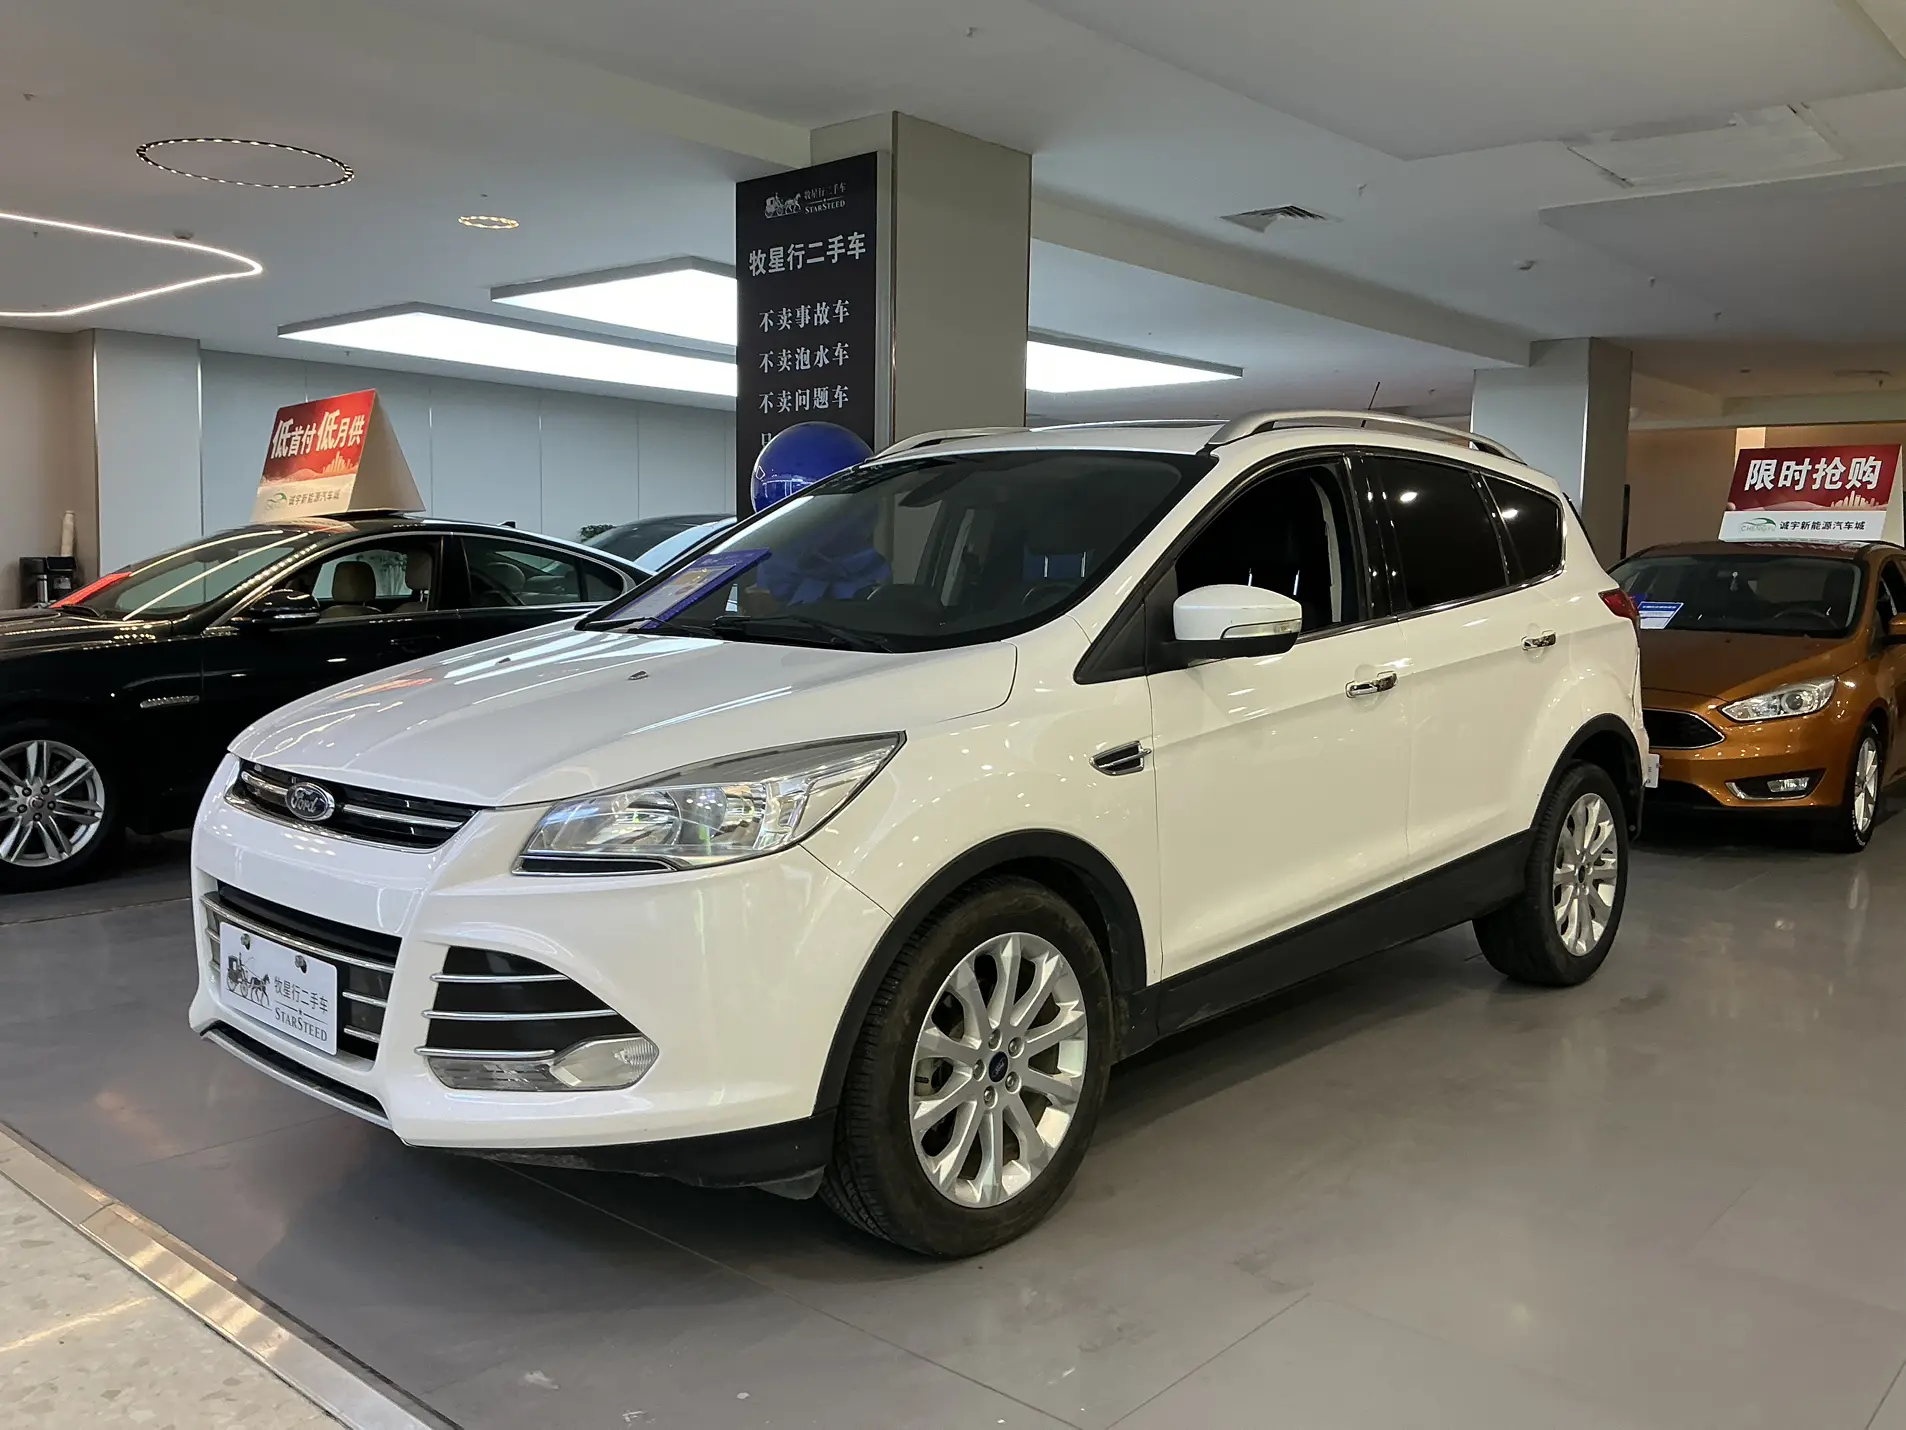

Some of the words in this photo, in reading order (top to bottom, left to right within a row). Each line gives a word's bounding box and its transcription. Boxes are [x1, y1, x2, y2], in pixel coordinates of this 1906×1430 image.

[748, 231, 867, 277] 牧星行二手车
[759, 299, 850, 333] 不卖事故车
[759, 342, 850, 374] 不卖泡水车
[759, 385, 849, 415] 不卖问题车
[270, 409, 366, 459] 低首付低月供
[1743, 456, 1882, 491] 限时抢购
[1779, 520, 1866, 531] 诚宇新能源汽车城
[290, 787, 319, 813] Ford
[273, 976, 329, 1014] 牧星行二手车
[274, 1007, 328, 1042] STARSTEED
